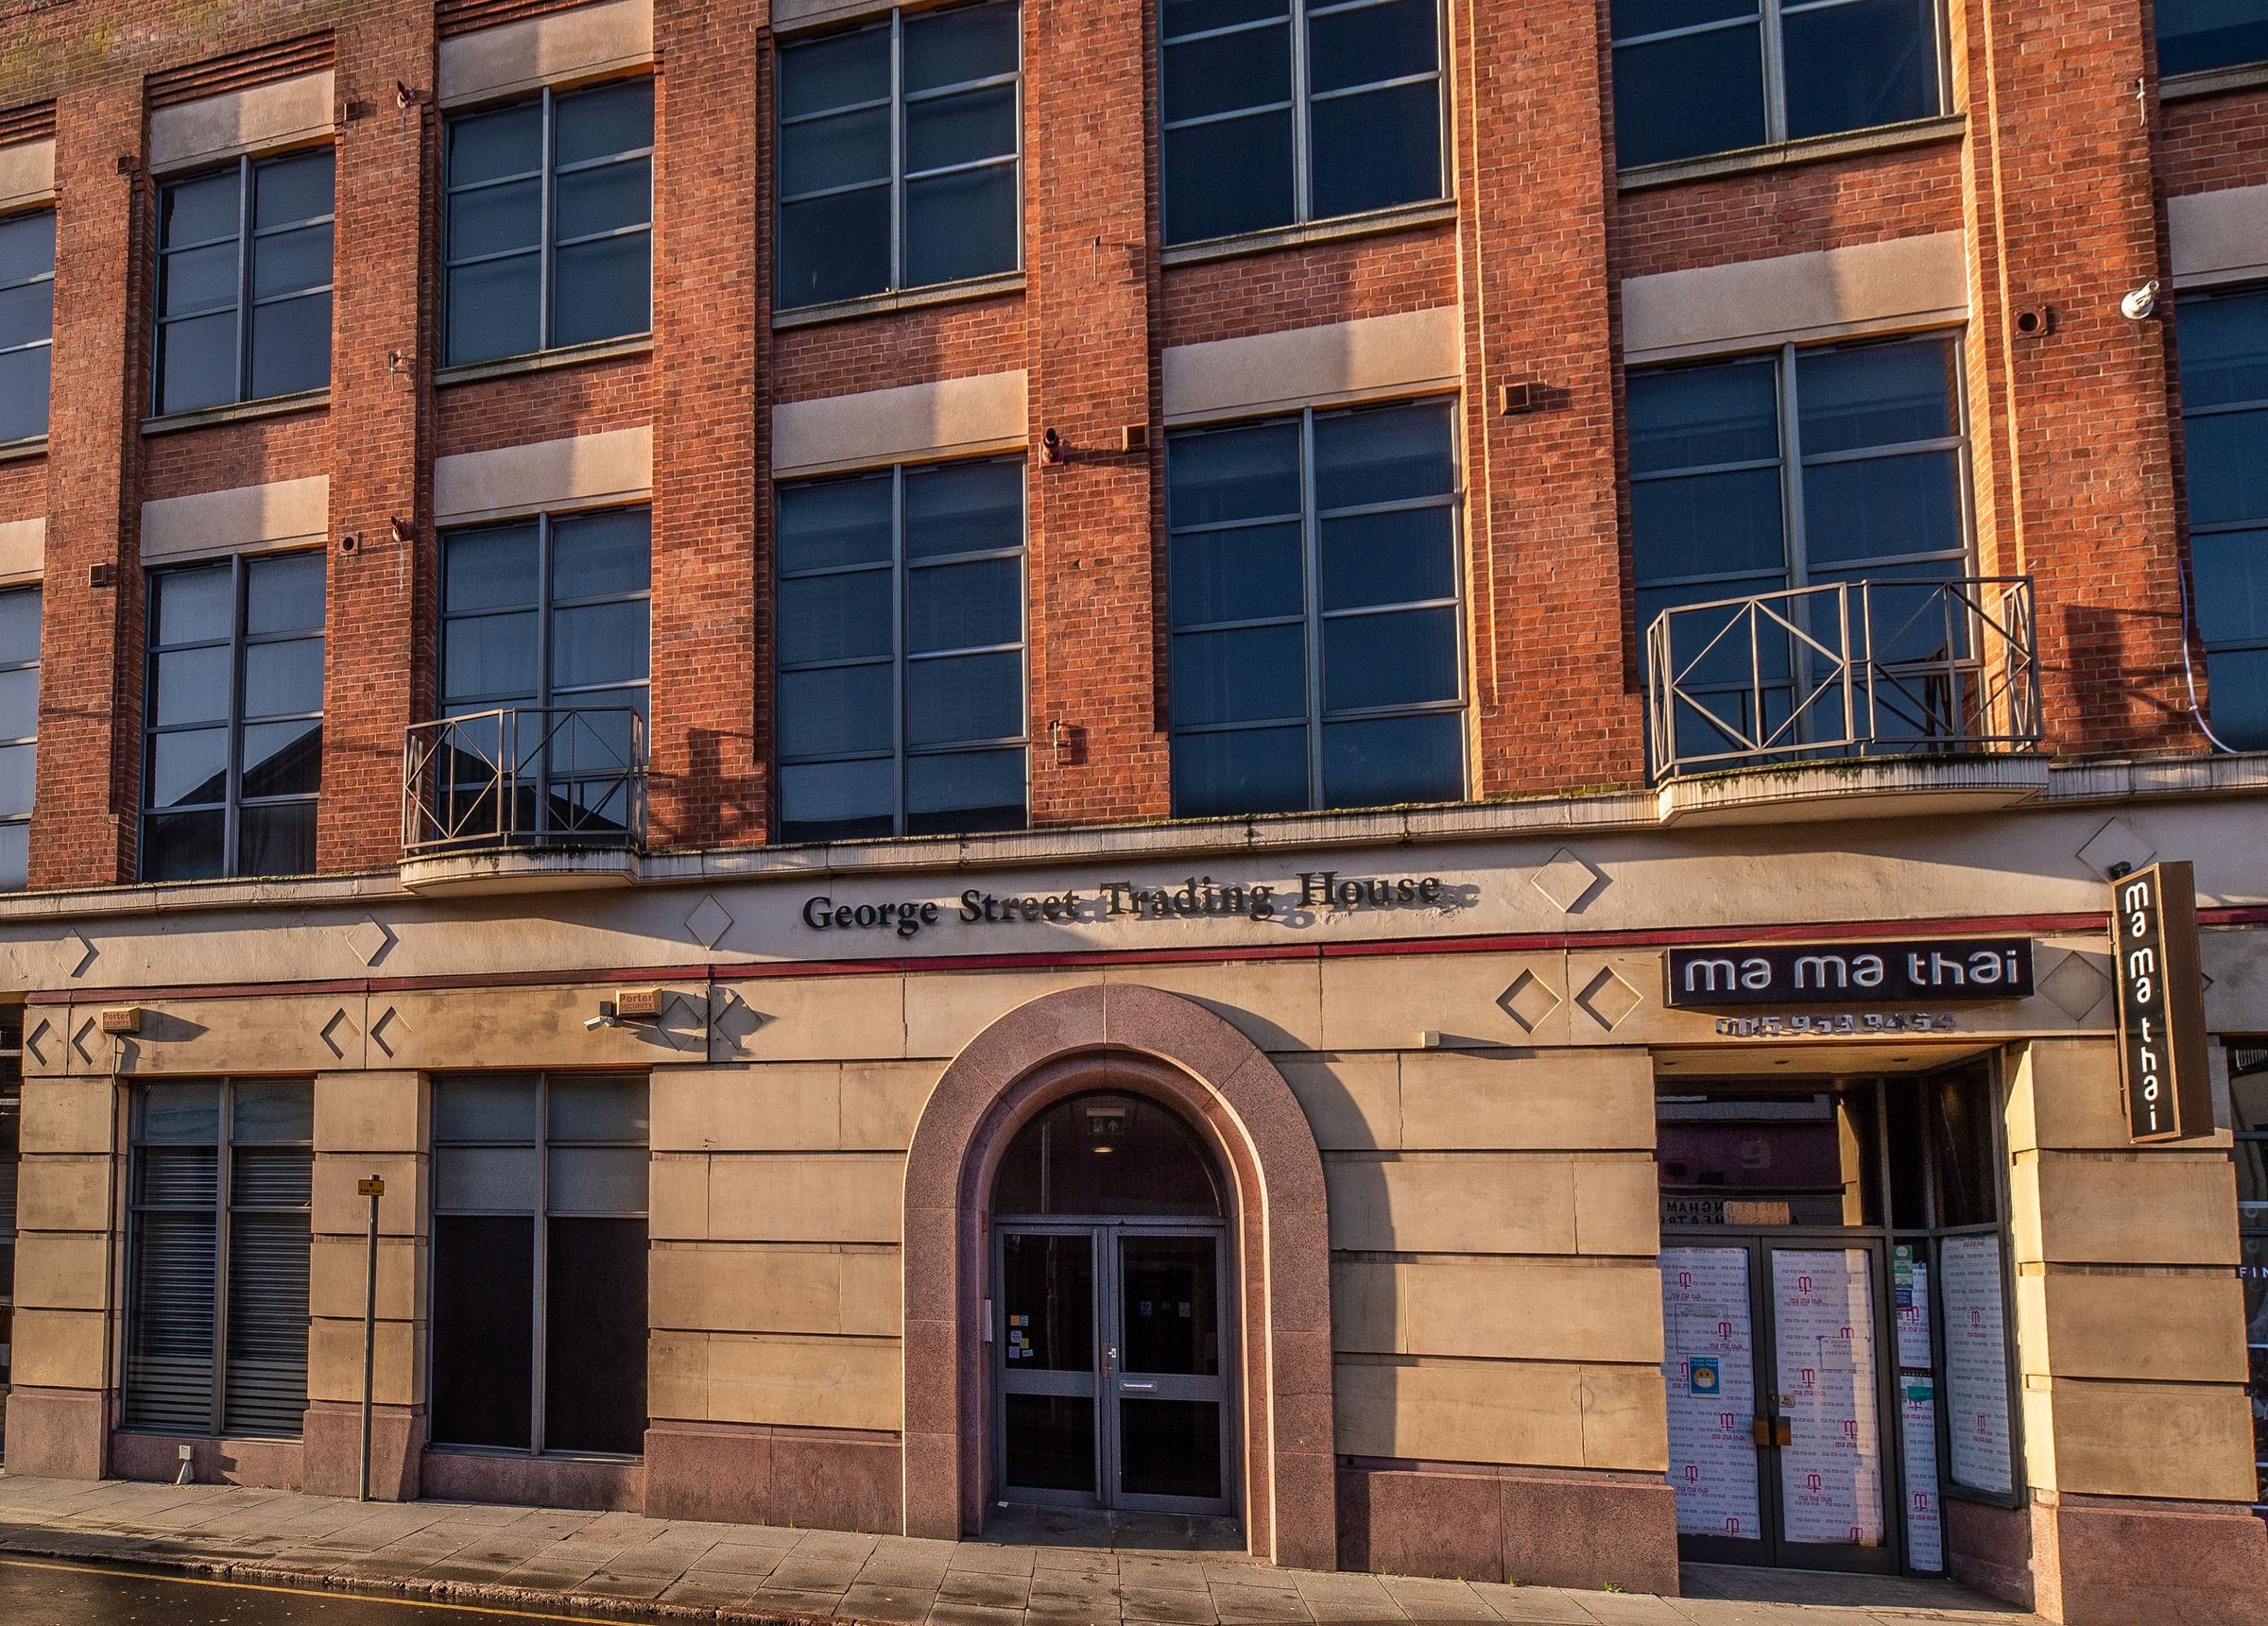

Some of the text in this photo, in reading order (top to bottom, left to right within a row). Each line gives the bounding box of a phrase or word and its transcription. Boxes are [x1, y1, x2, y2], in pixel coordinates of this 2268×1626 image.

[803, 870, 1441, 937] George Street Trading House
[1685, 950, 2019, 991] ma ma thai
[103, 1011, 129, 1020] Porter
[619, 993, 653, 1002] Porter
[2125, 881, 2159, 1131] ma ma thai
